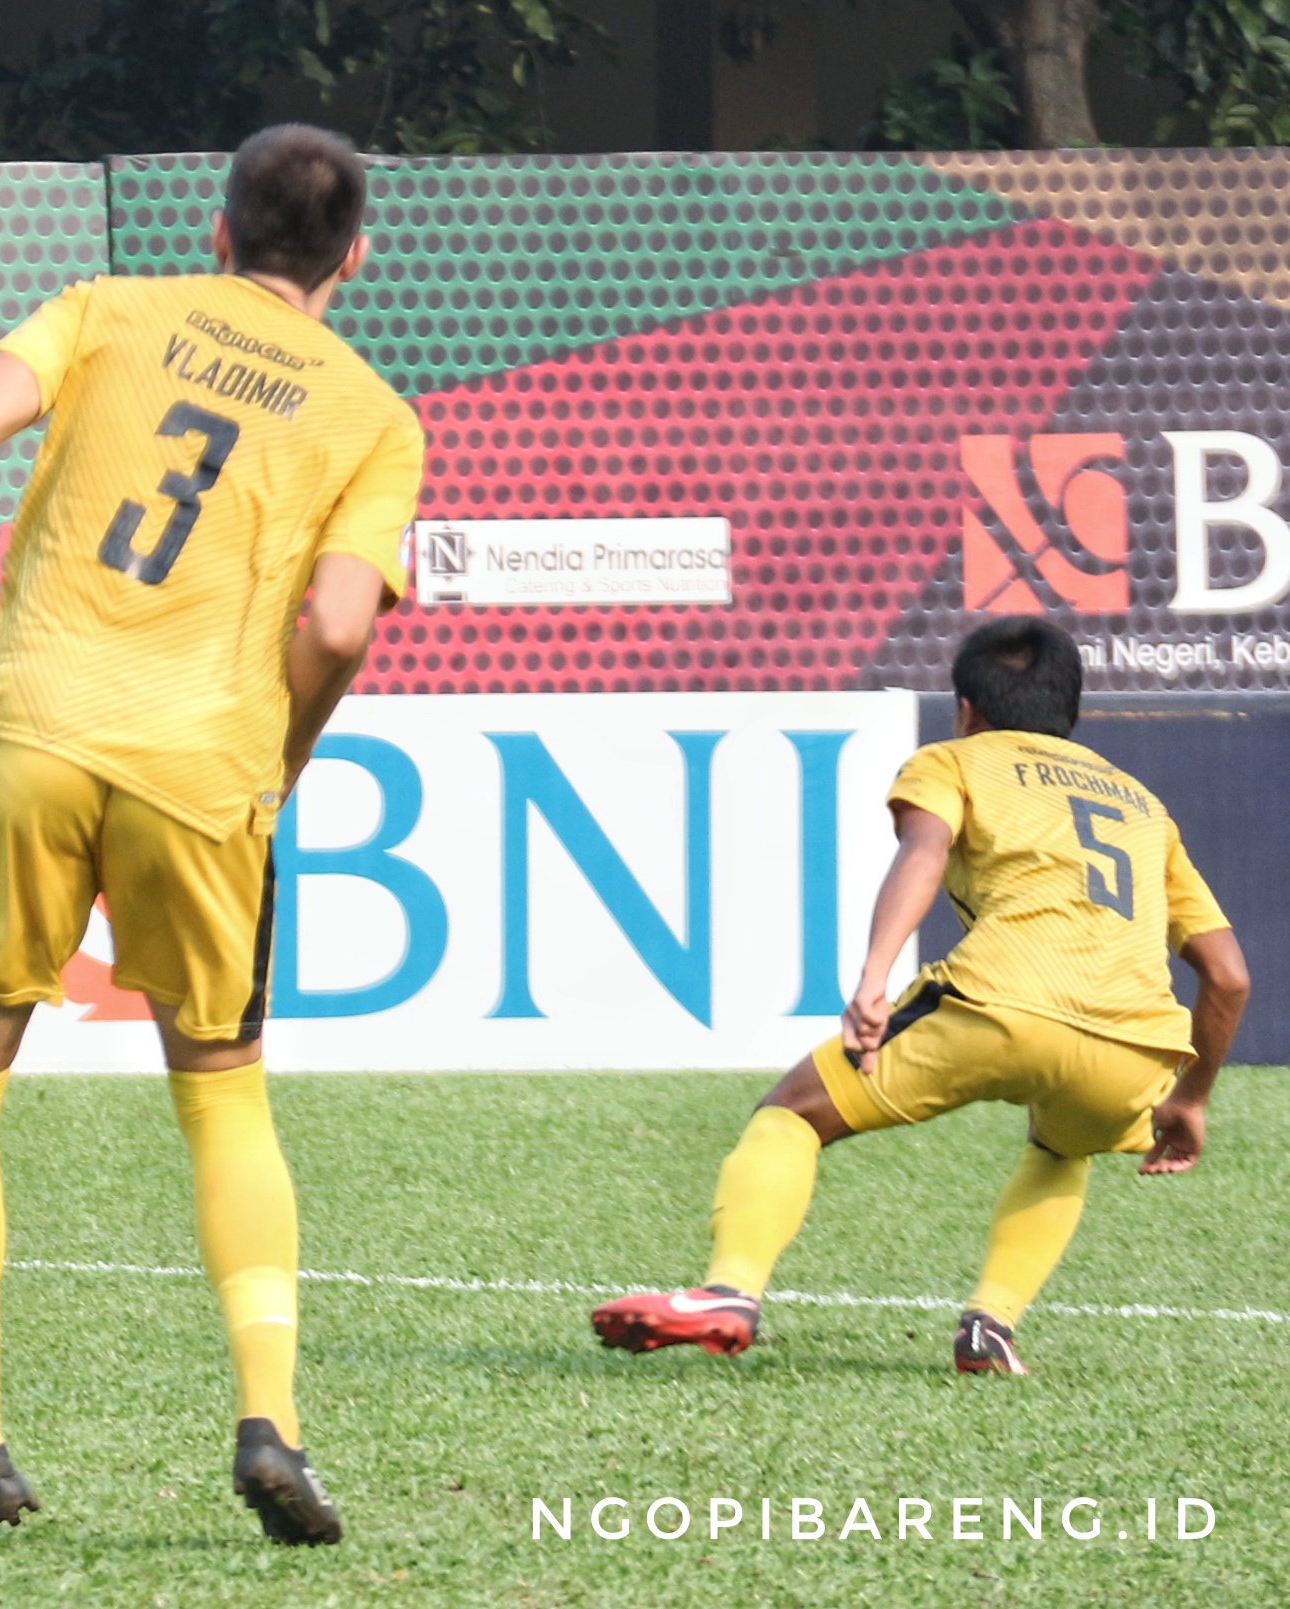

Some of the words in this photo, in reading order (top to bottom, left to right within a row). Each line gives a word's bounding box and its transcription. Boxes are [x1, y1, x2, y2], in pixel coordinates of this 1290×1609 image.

[161, 333, 308, 421] VLADIMIR
[98, 400, 240, 586] 3
[1162, 430, 1290, 615] B
[486, 544, 583, 572] Nendia
[593, 543, 728, 571] Primarasa
[1013, 763, 1029, 787] F
[1035, 762, 1152, 818] ROCHMAN
[267, 730, 858, 1031] BNI
[1067, 795, 1134, 922] 5
